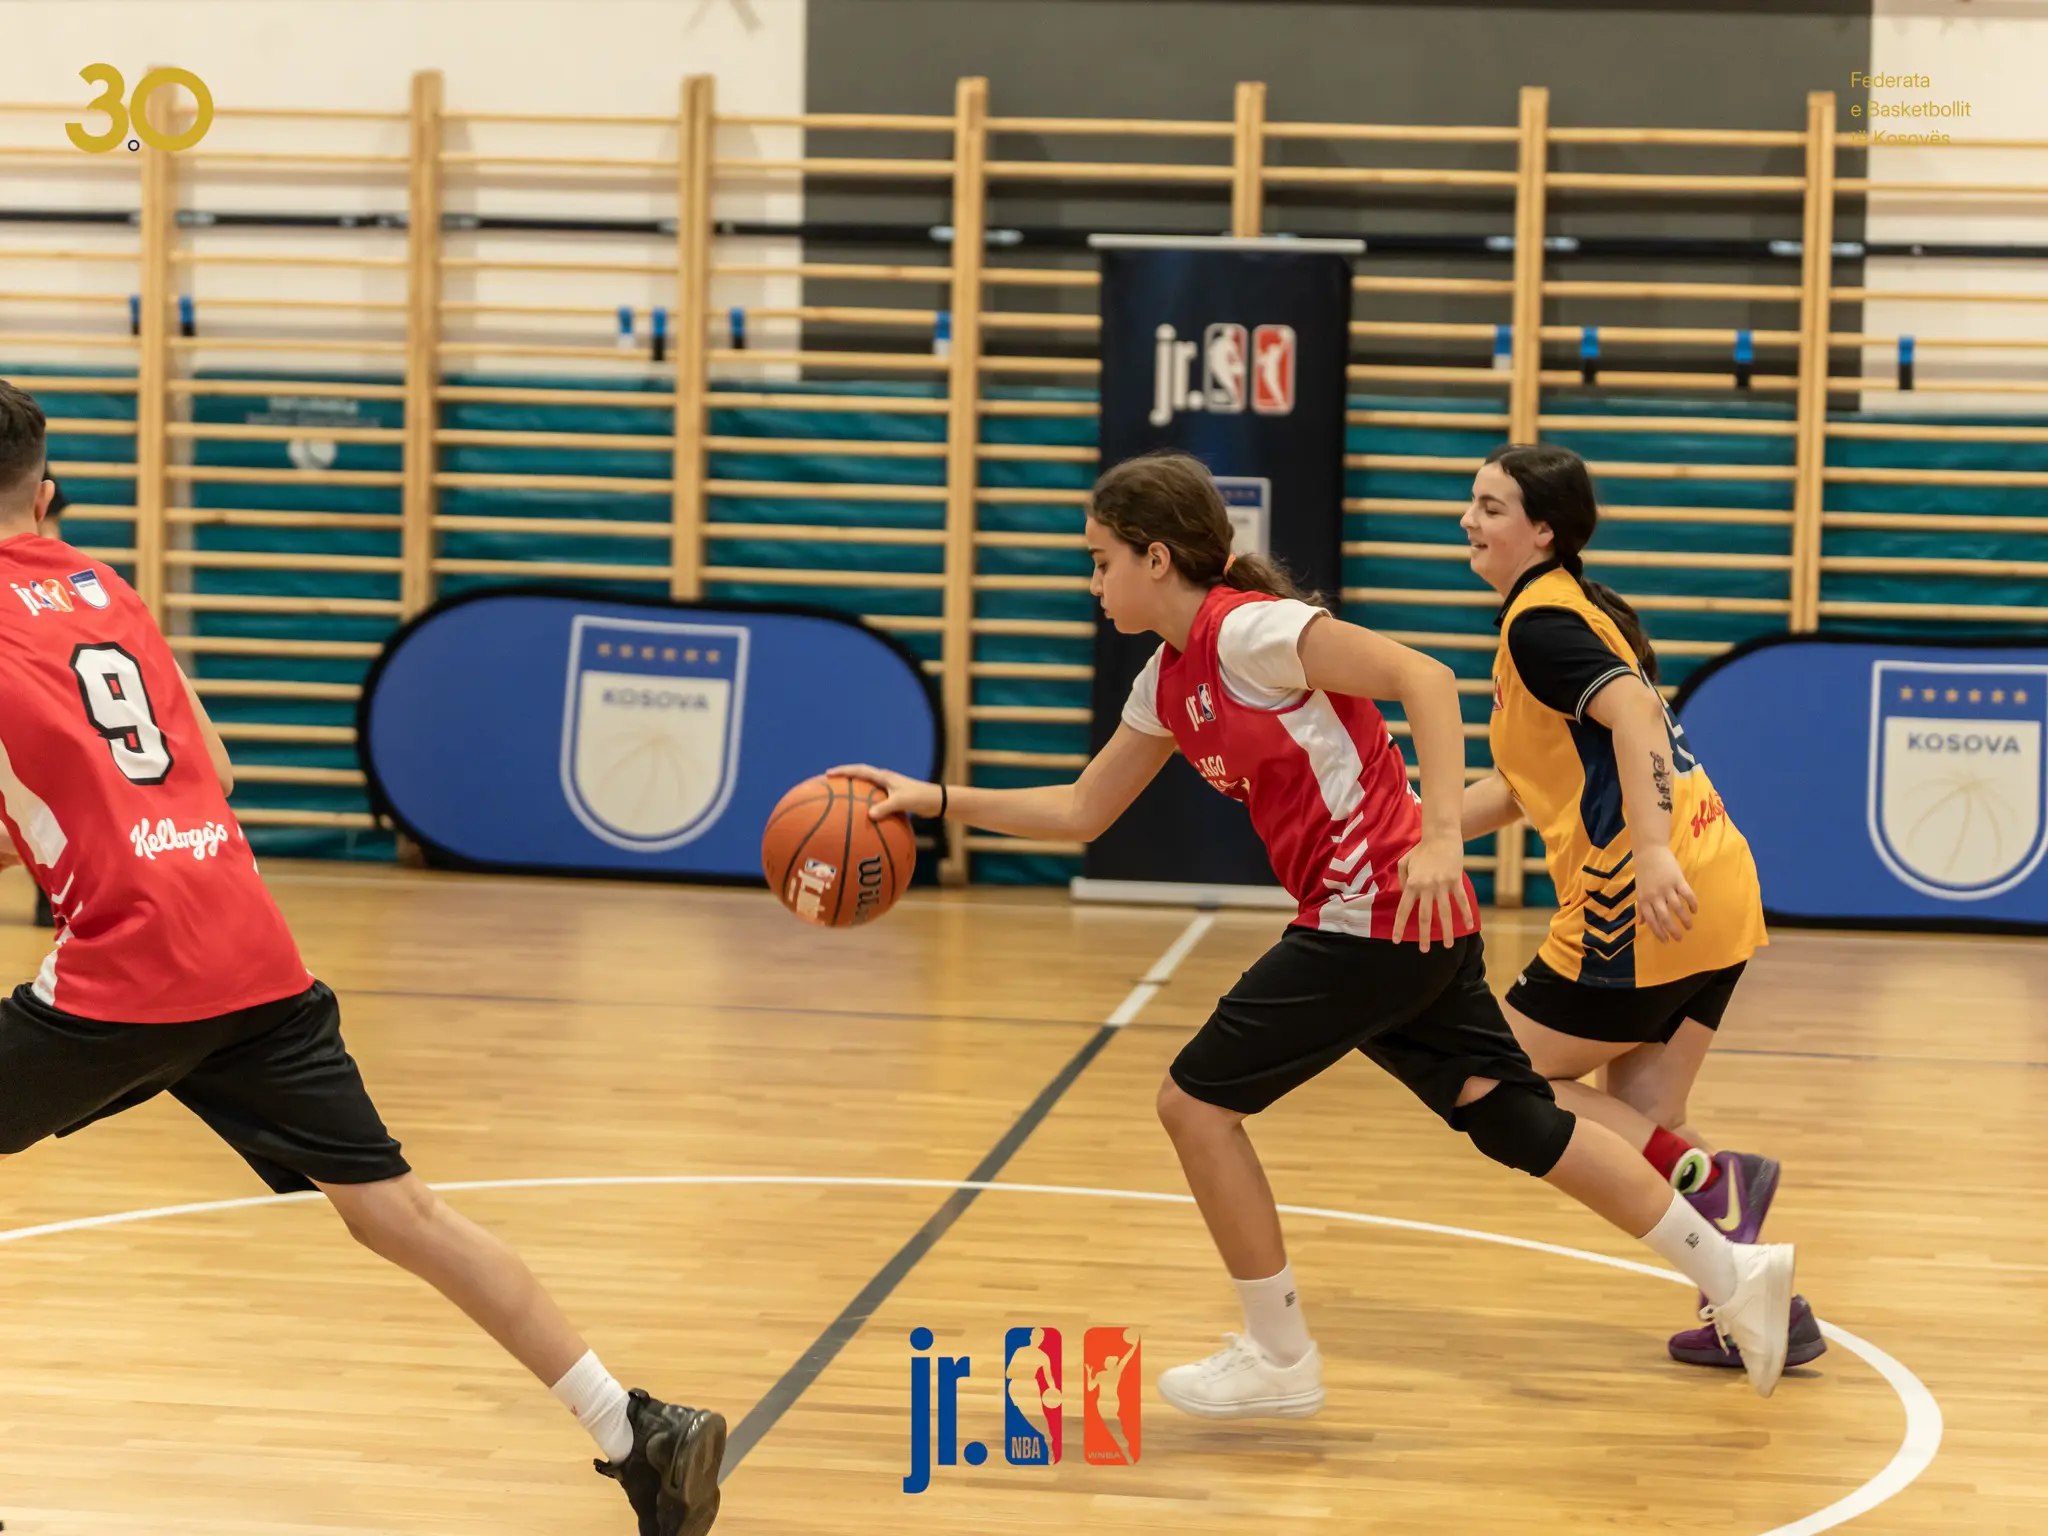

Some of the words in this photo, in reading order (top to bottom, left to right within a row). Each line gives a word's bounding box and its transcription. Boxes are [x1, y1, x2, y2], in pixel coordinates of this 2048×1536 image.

[1149, 323, 1204, 427] jr.
[69, 641, 175, 786] 9
[1908, 732, 2021, 755] KOSOVA
[129, 817, 228, 860] Kellogg's
